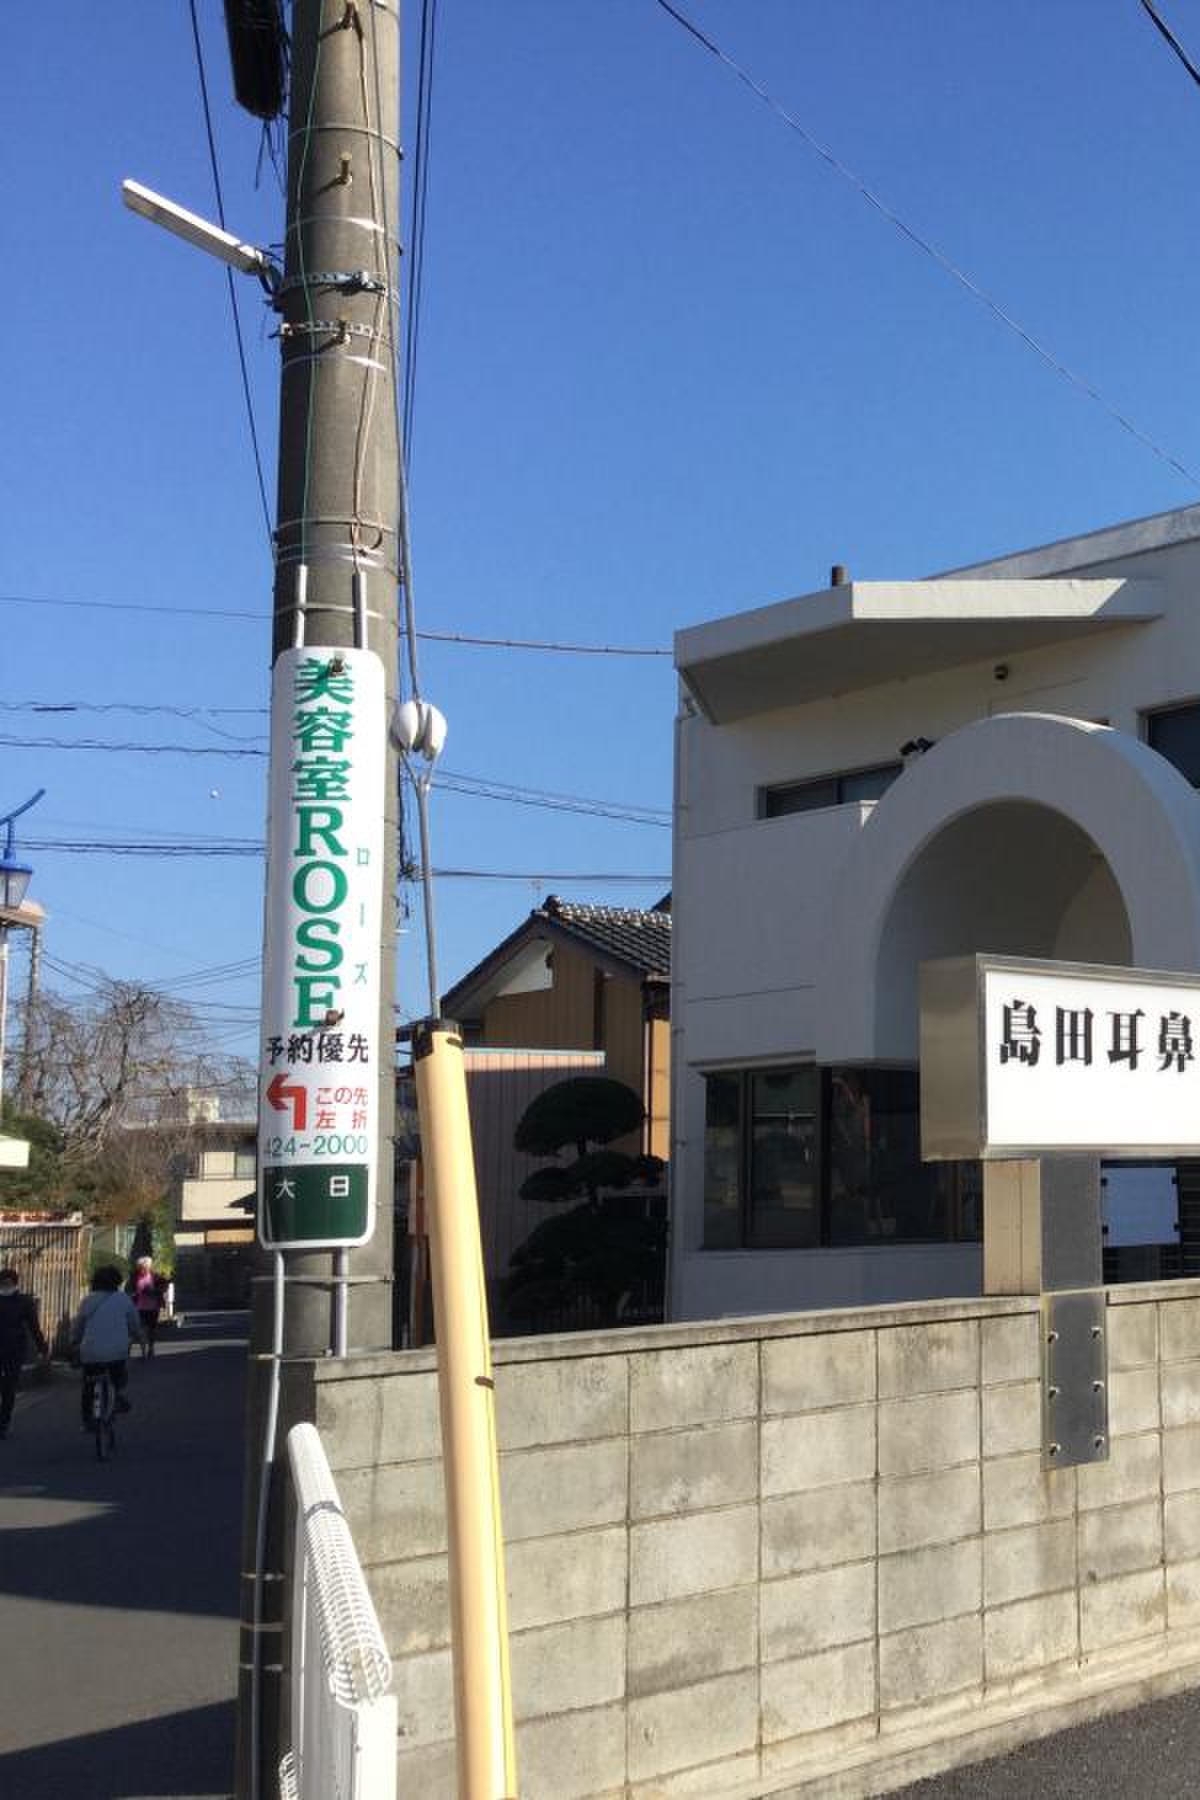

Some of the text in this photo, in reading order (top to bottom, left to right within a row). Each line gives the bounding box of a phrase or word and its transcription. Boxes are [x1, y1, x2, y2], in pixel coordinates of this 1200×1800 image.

[292, 658, 354, 1028] 美容室ROSE
[267, 1033, 369, 1065] 予約優先
[316, 1087, 368, 1106] この先
